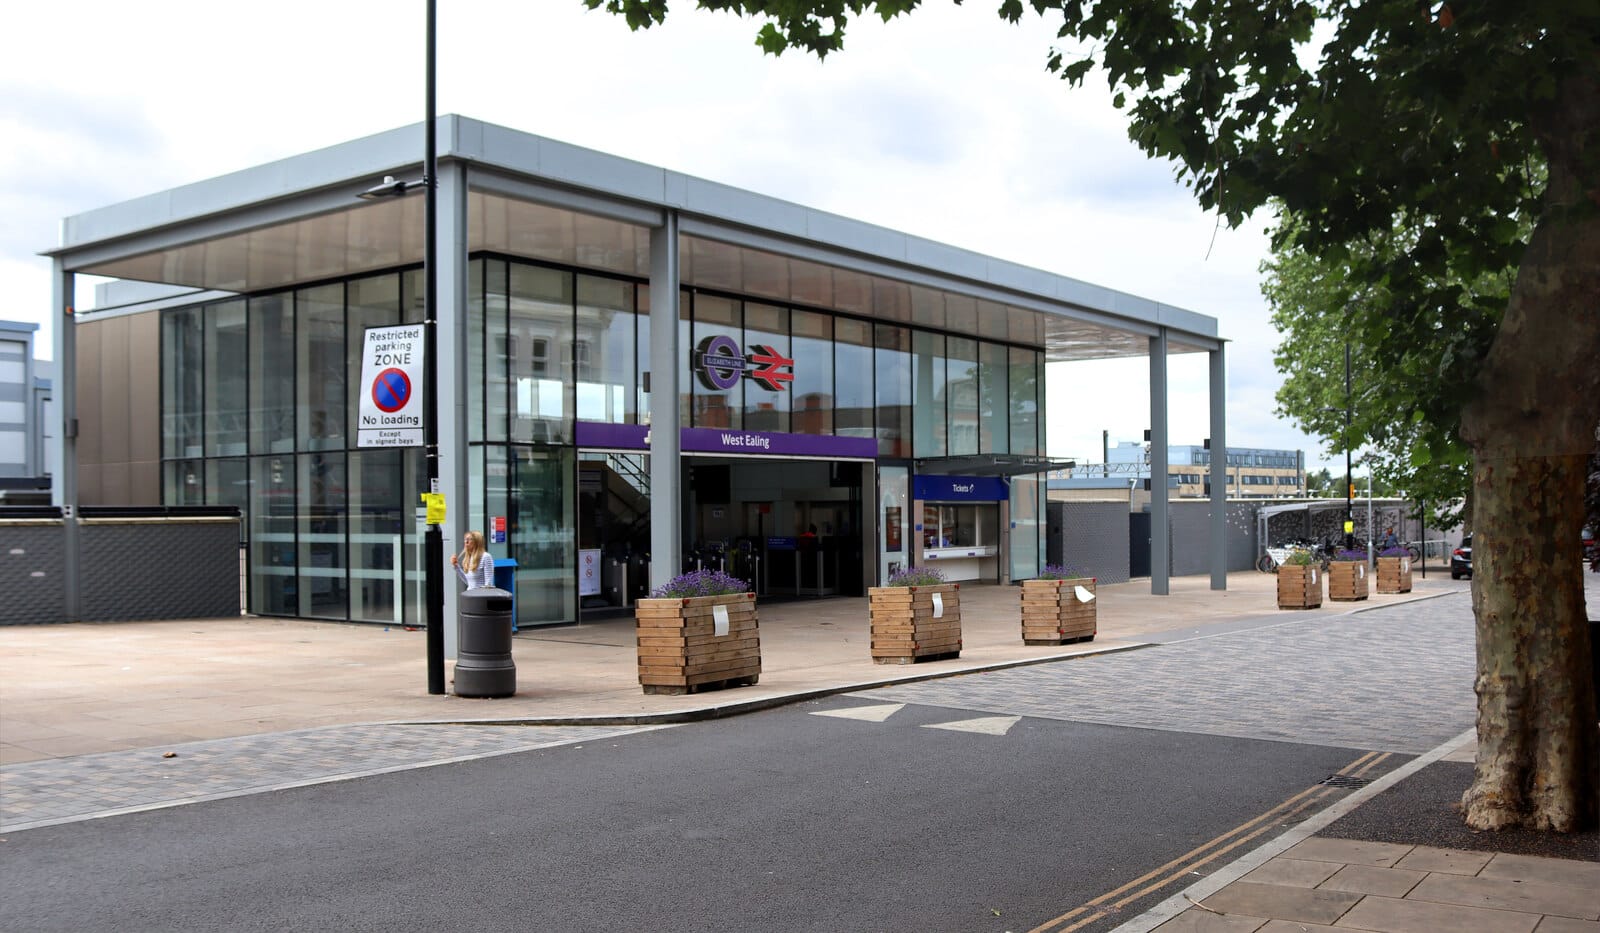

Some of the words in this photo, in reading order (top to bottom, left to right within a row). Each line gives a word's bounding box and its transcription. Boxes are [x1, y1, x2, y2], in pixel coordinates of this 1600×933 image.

[369, 329, 419, 341] Restricted
[375, 342, 412, 353] parking
[374, 353, 411, 366] ZONE
[706, 356, 731, 367] ELIZABETH
[362, 416, 377, 425] No
[381, 414, 419, 426] loading
[721, 433, 744, 446] West
[745, 434, 770, 450] Ealing
[952, 484, 969, 493] Tickets
